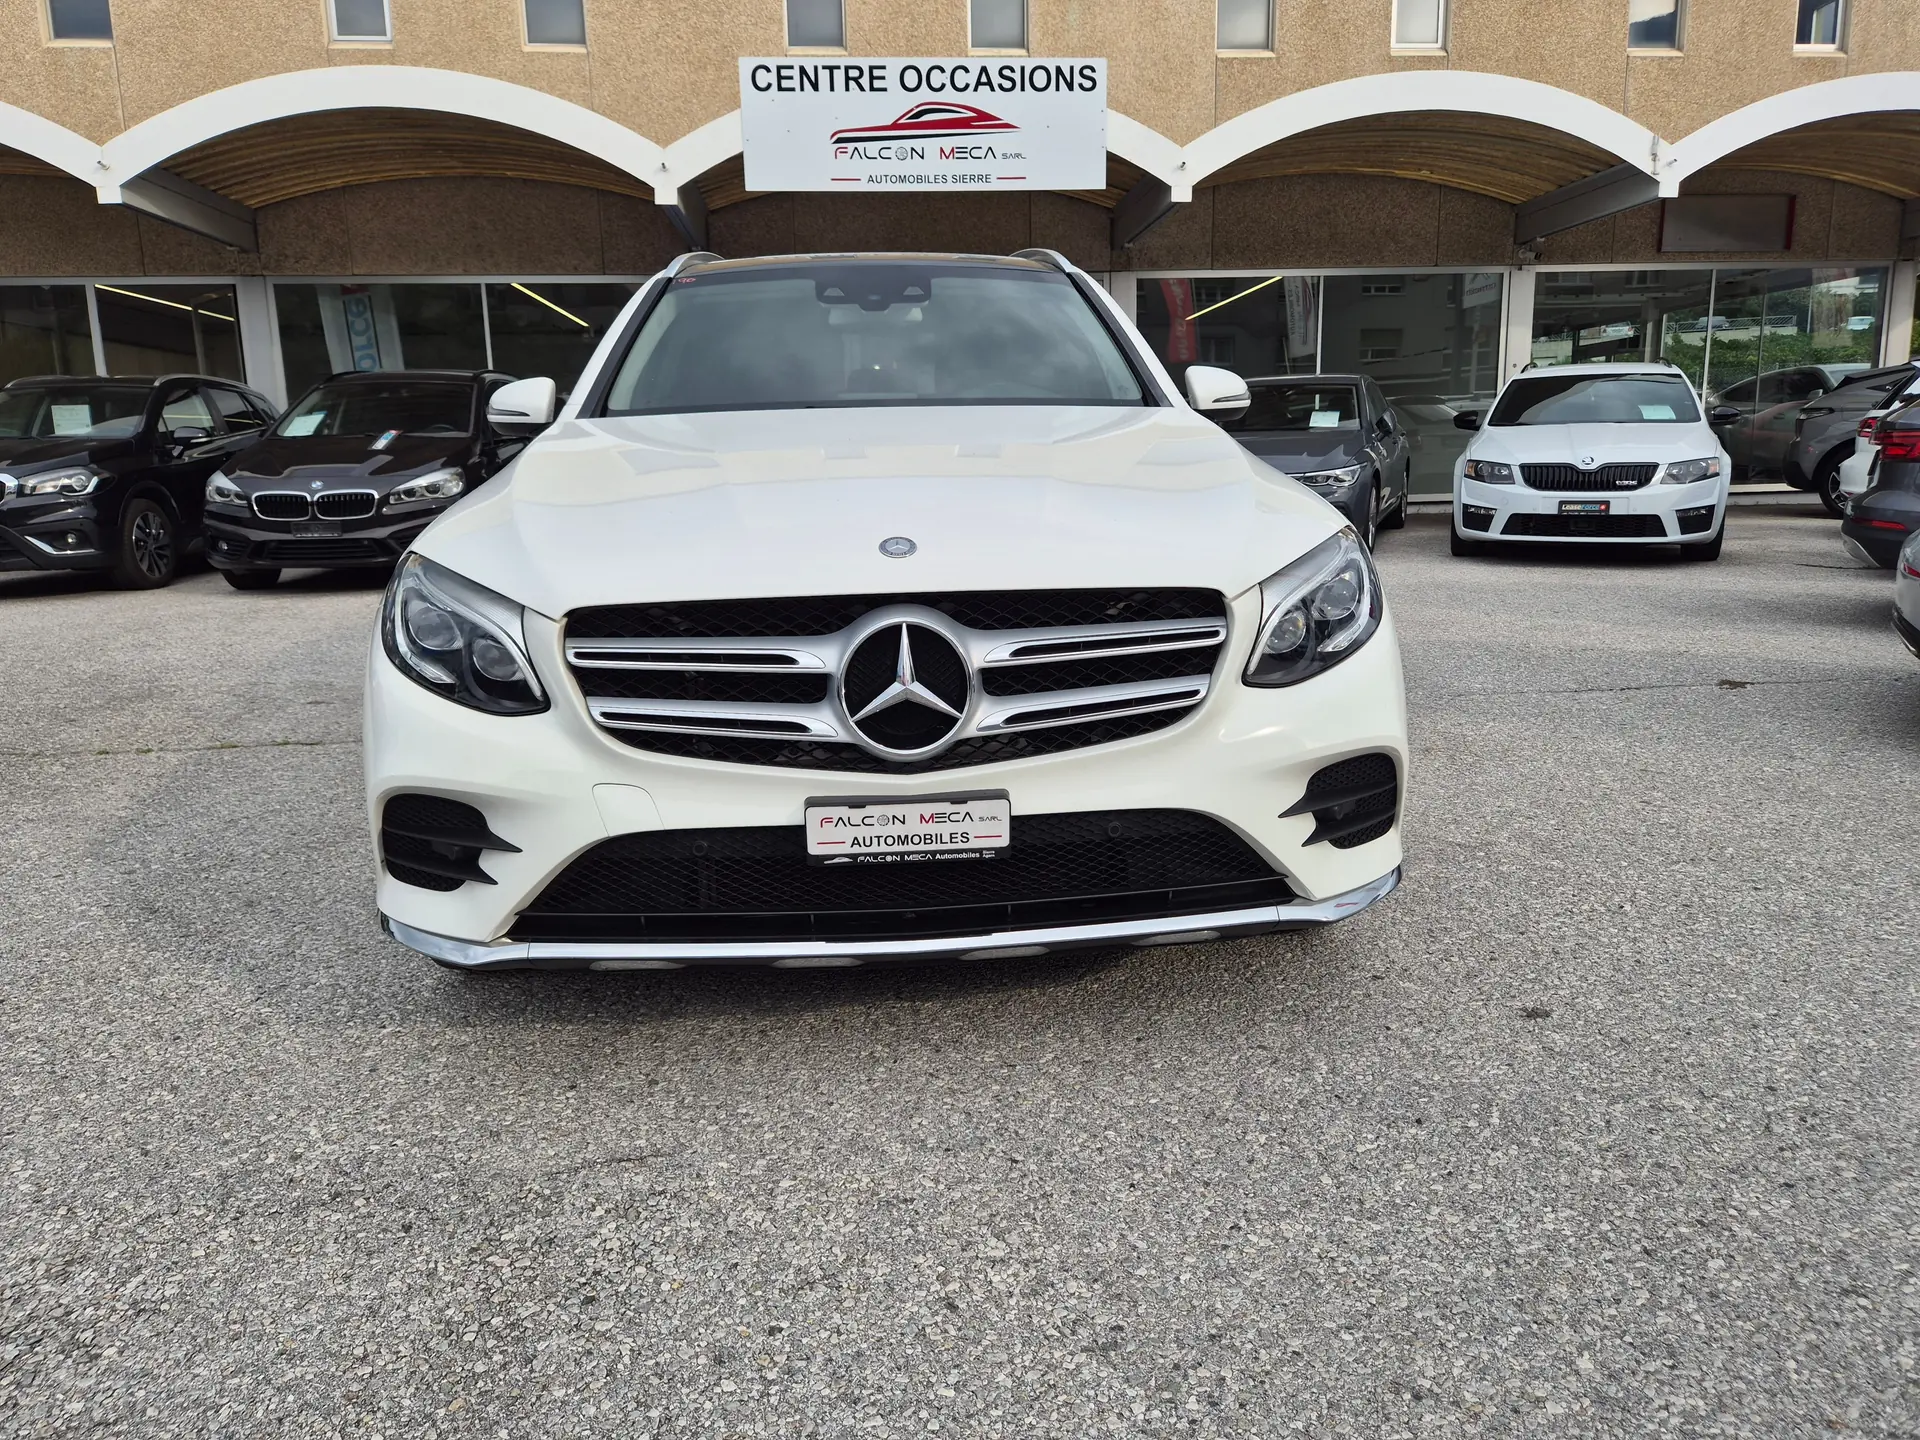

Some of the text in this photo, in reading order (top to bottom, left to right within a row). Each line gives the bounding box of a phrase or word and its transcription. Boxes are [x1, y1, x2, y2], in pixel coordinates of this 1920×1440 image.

[750, 64, 1098, 93] CENTRE OCCASIONS
[834, 146, 925, 161] FALCON
[939, 145, 997, 160] MECA
[866, 173, 992, 184] AUTOMOBILES SIERRE
[819, 814, 906, 829] FALCON
[919, 811, 974, 825] MECA
[850, 831, 970, 848] AUTOMOBILES
[857, 855, 900, 863] FALCON
[904, 853, 933, 861] MECA
[935, 851, 980, 860] Automobiles
